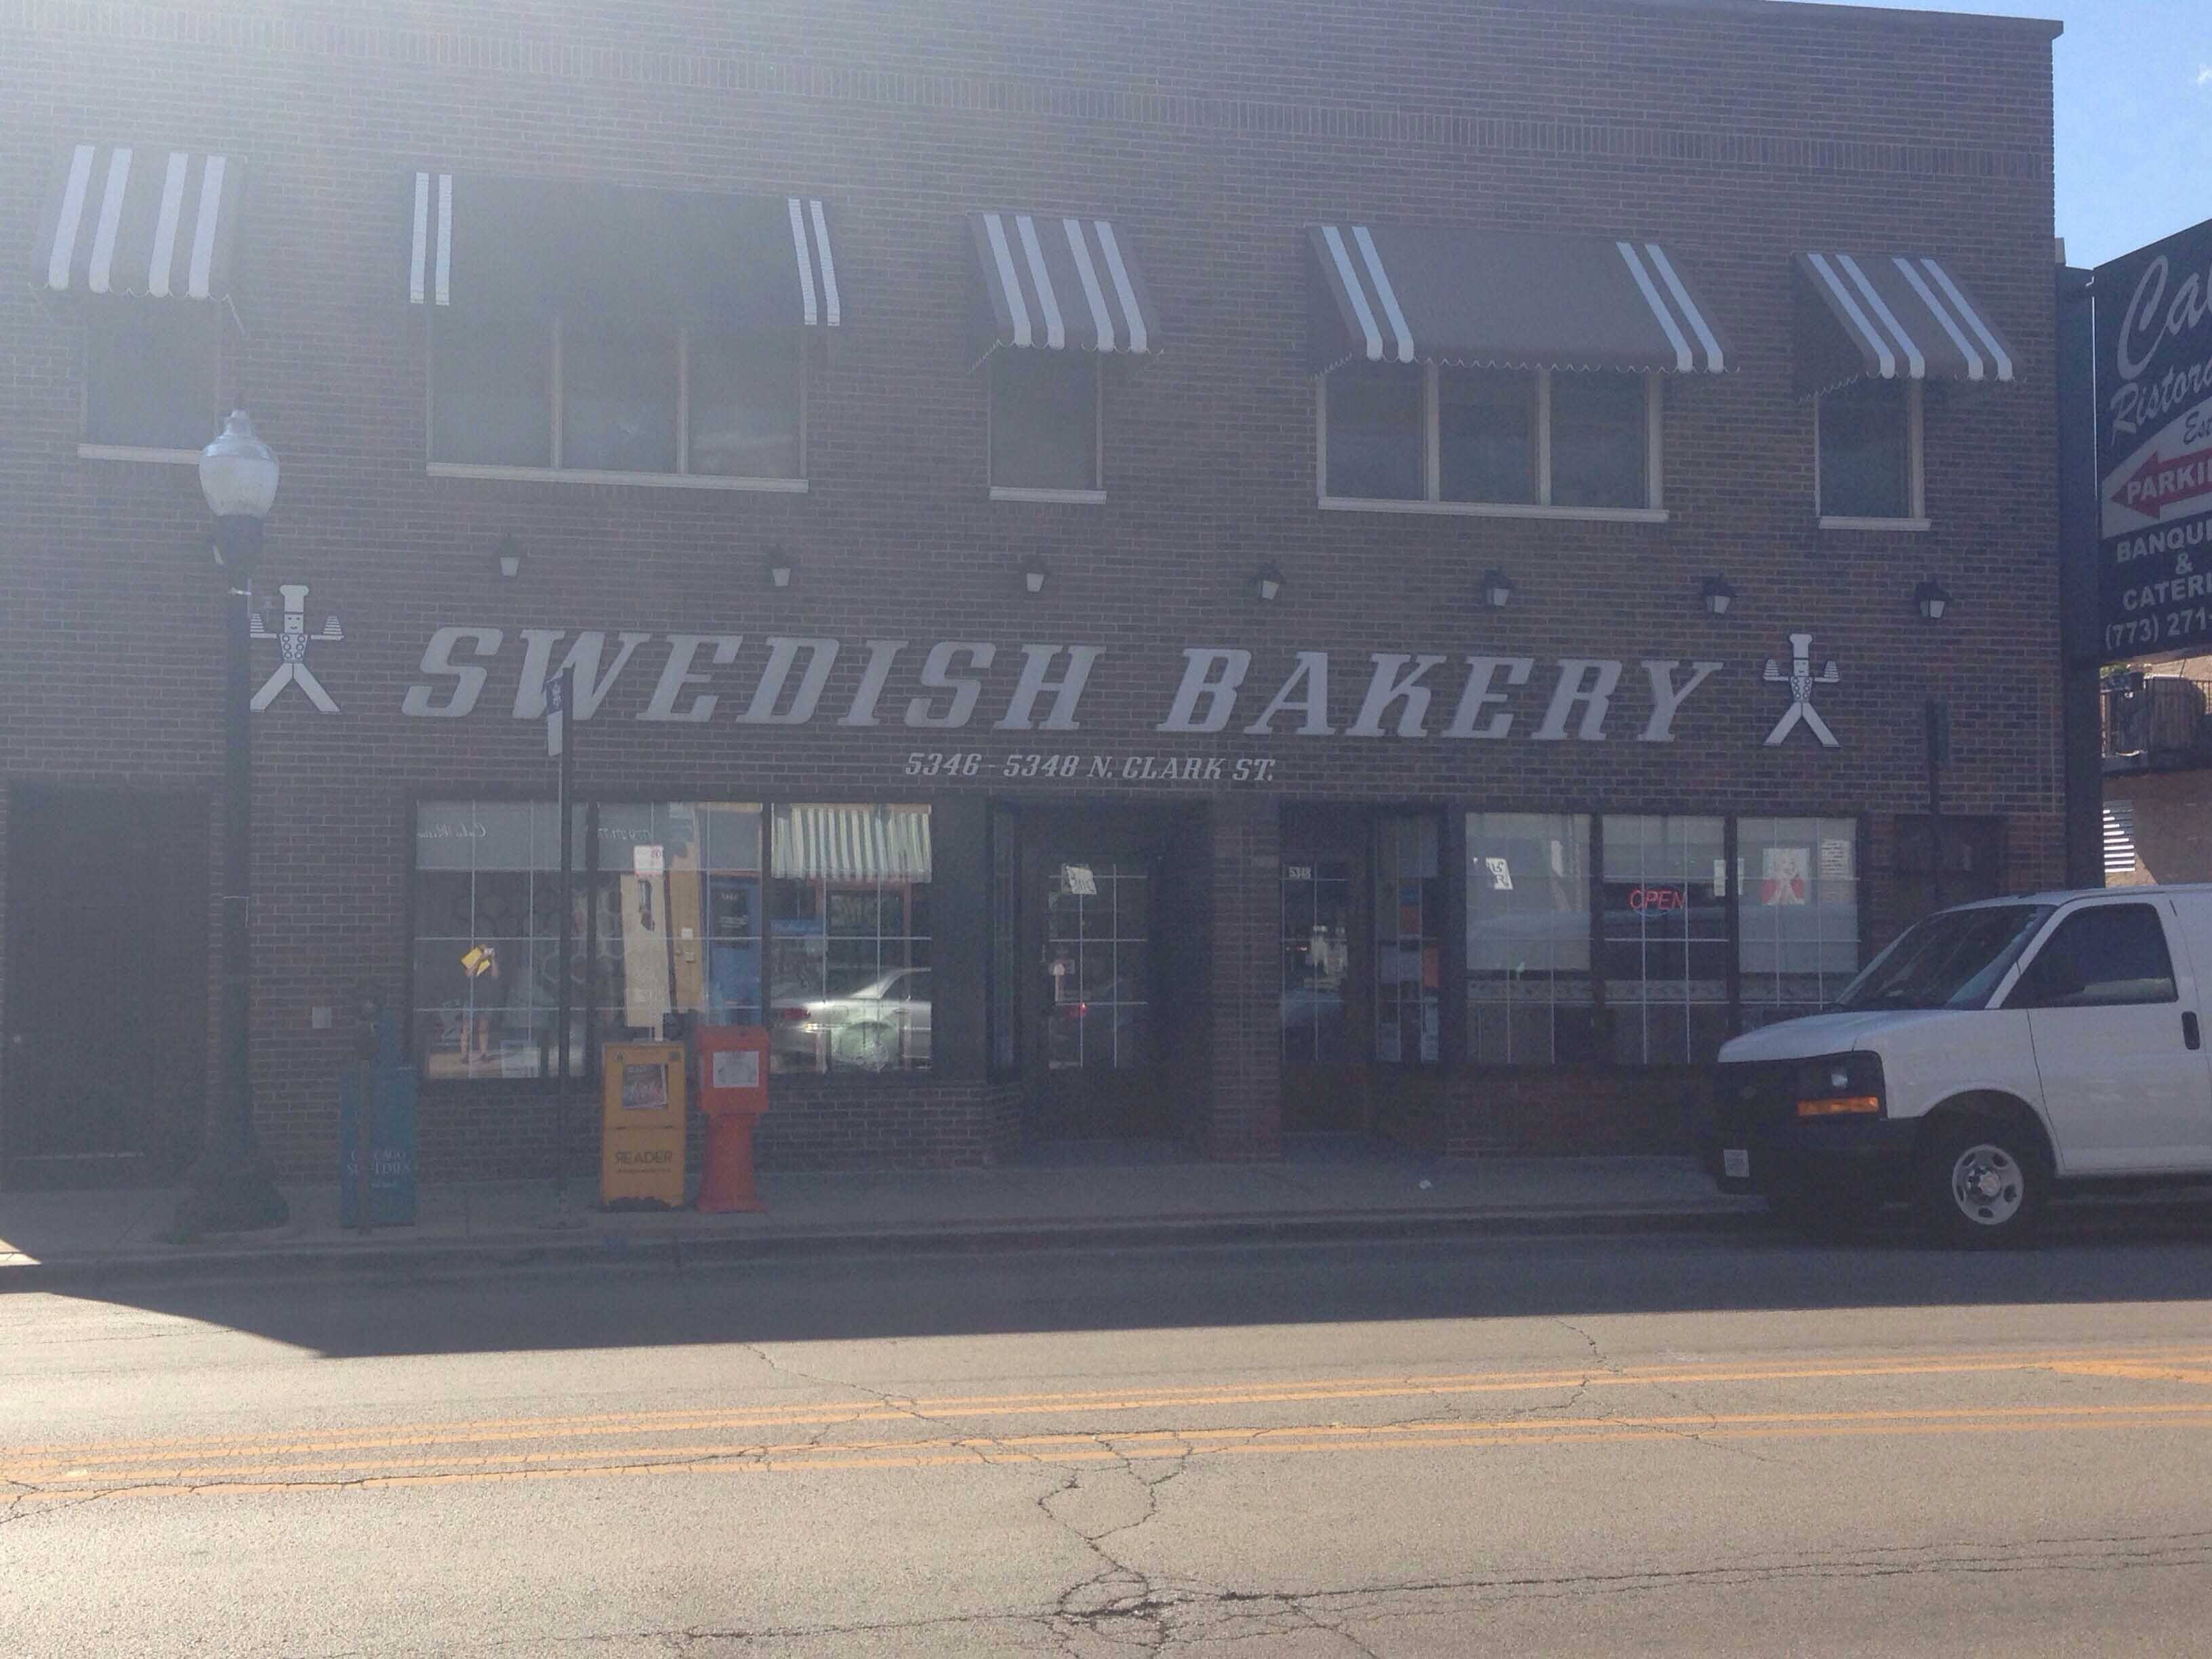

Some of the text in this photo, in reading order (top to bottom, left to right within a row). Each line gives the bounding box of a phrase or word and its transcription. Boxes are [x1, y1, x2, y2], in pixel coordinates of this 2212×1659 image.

[2175, 552, 2193, 575] &
[2105, 613, 2159, 651] (773)
[401, 626, 1723, 742] SWEDISH BAKERY
[905, 752, 981, 776] 5346
[1003, 754, 1080, 777] 5348
[1087, 756, 1113, 779] N.
[1122, 756, 1225, 780] CLARK
[1231, 758, 1277, 781] ST.
[1628, 888, 1687, 910] OPEN
[613, 1150, 673, 1164] READER
